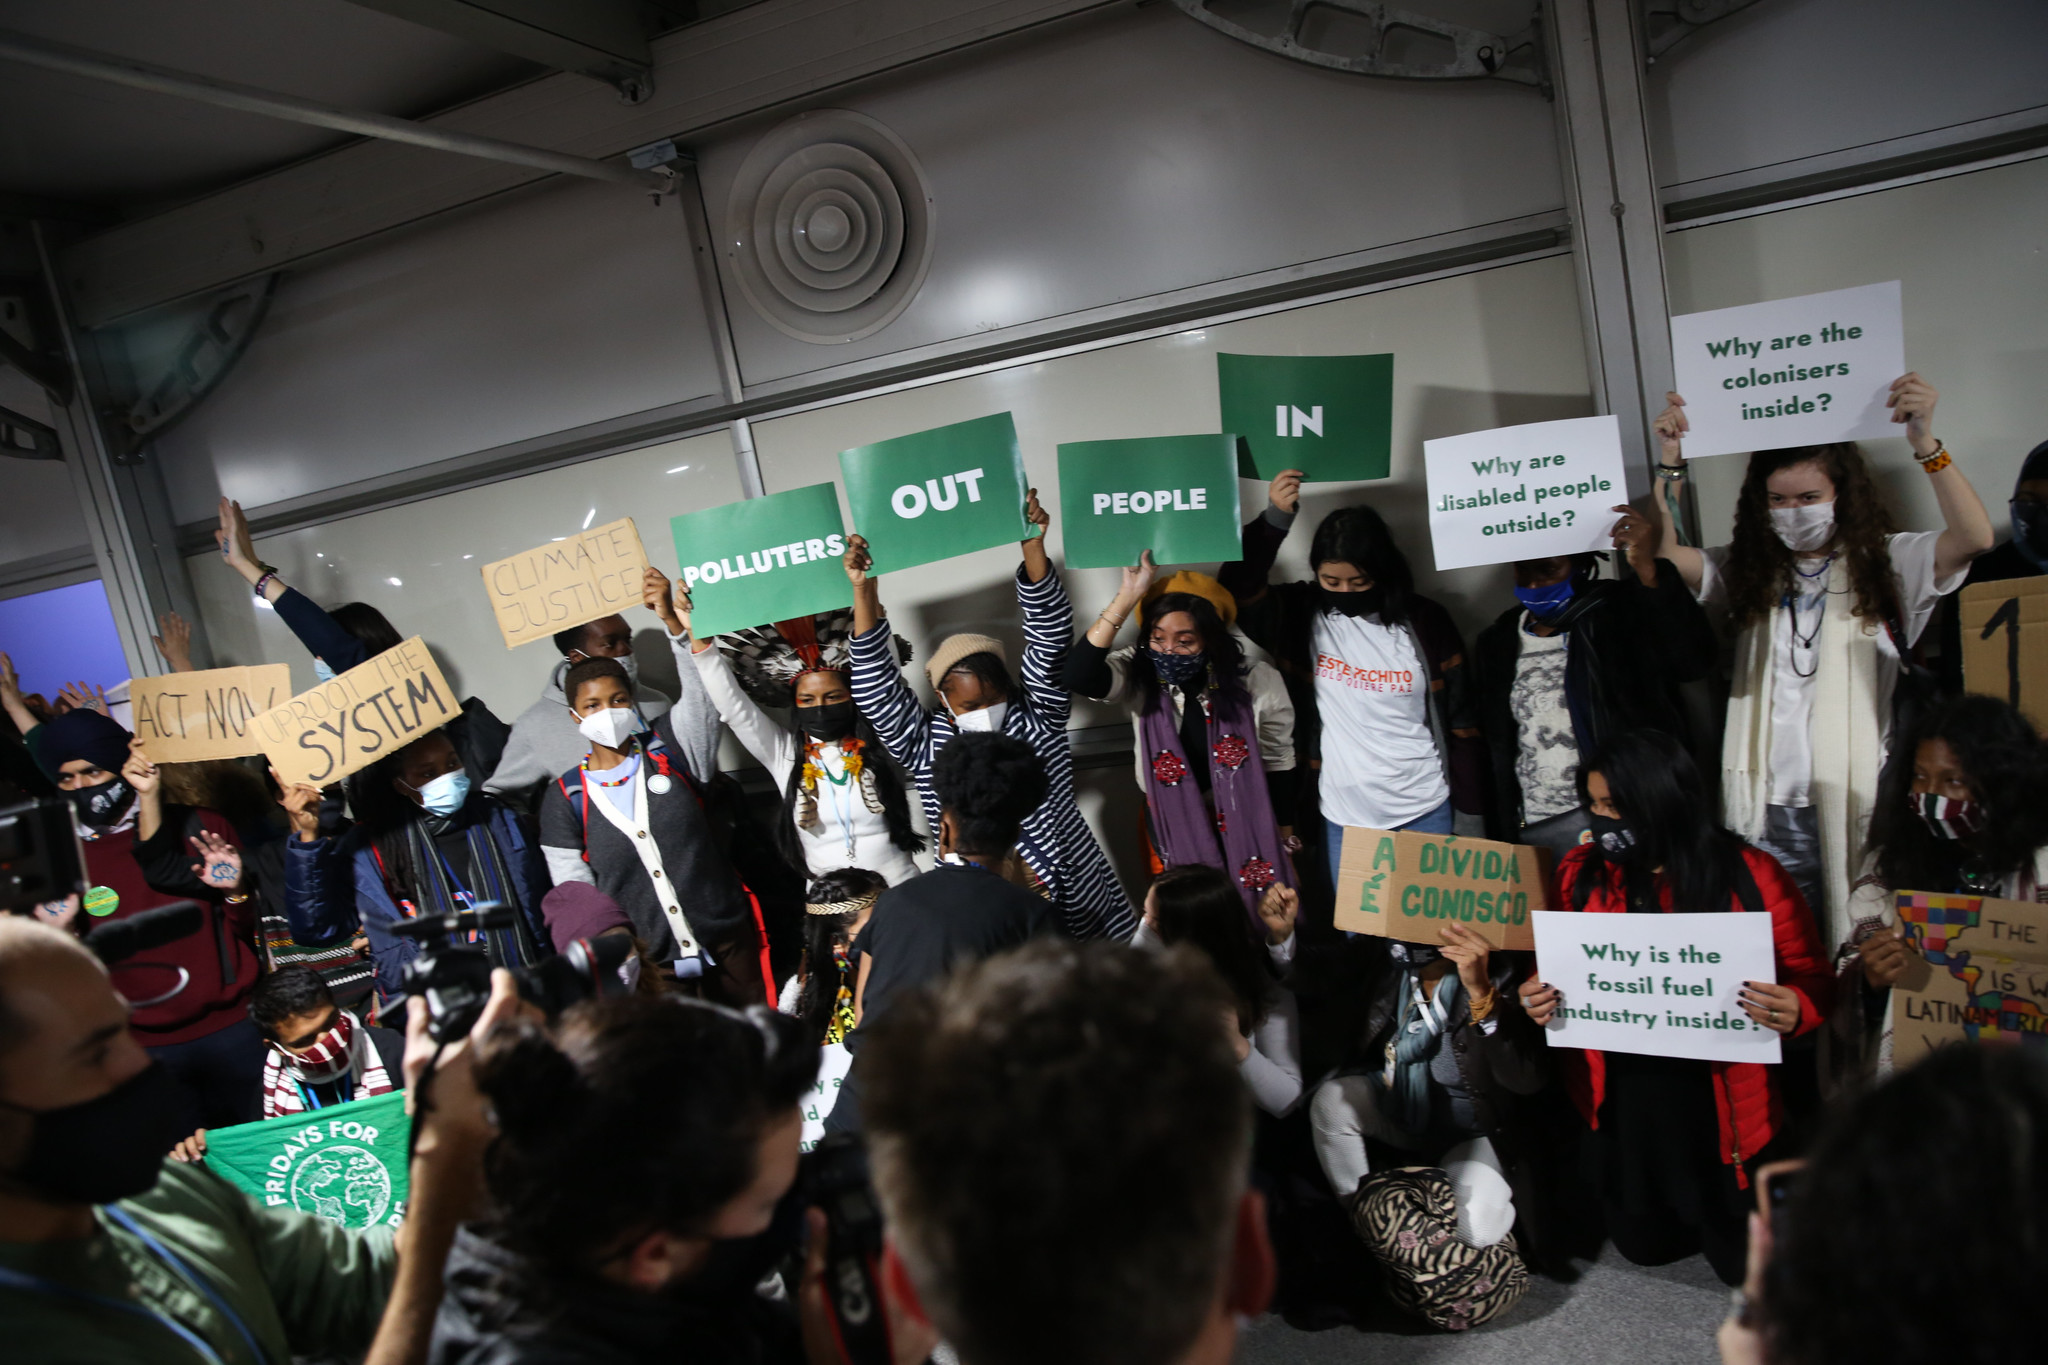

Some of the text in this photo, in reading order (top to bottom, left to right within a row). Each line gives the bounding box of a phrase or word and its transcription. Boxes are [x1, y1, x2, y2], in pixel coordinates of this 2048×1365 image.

[1705, 322, 1863, 359] Why are the
[1723, 362, 1850, 390] colonisers
[1276, 404, 1324, 438] IN
[1742, 393, 1832, 421] inside?
[1471, 454, 1566, 476] Why are
[891, 467, 984, 520] OUT
[1093, 488, 1207, 516] PEOPLE
[1436, 474, 1611, 512] disabled people
[1482, 510, 1575, 536] outside?
[493, 526, 634, 597] CLIMATE
[683, 534, 846, 588] POLLUTERS
[501, 566, 645, 633] JUSTICE
[1315, 667, 1413, 693] SOLO QUIERE PAZ
[1317, 654, 1413, 683] ESTE PECHITO
[258, 643, 426, 743] UPROOT THE
[137, 692, 187, 739] ACT
[299, 671, 448, 781] SYSTEM
[1373, 836, 1521, 883] A DÍVIDA
[1360, 873, 1528, 925] É CONOSCO
[1988, 920, 2037, 943] THE
[1581, 943, 1722, 967] Why is the
[1587, 973, 1713, 997] fossil fuel
[1991, 970, 2016, 992] IS
[1555, 1003, 1657, 1029] industry
[265, 1121, 379, 1206] FRIDAYS FOR
